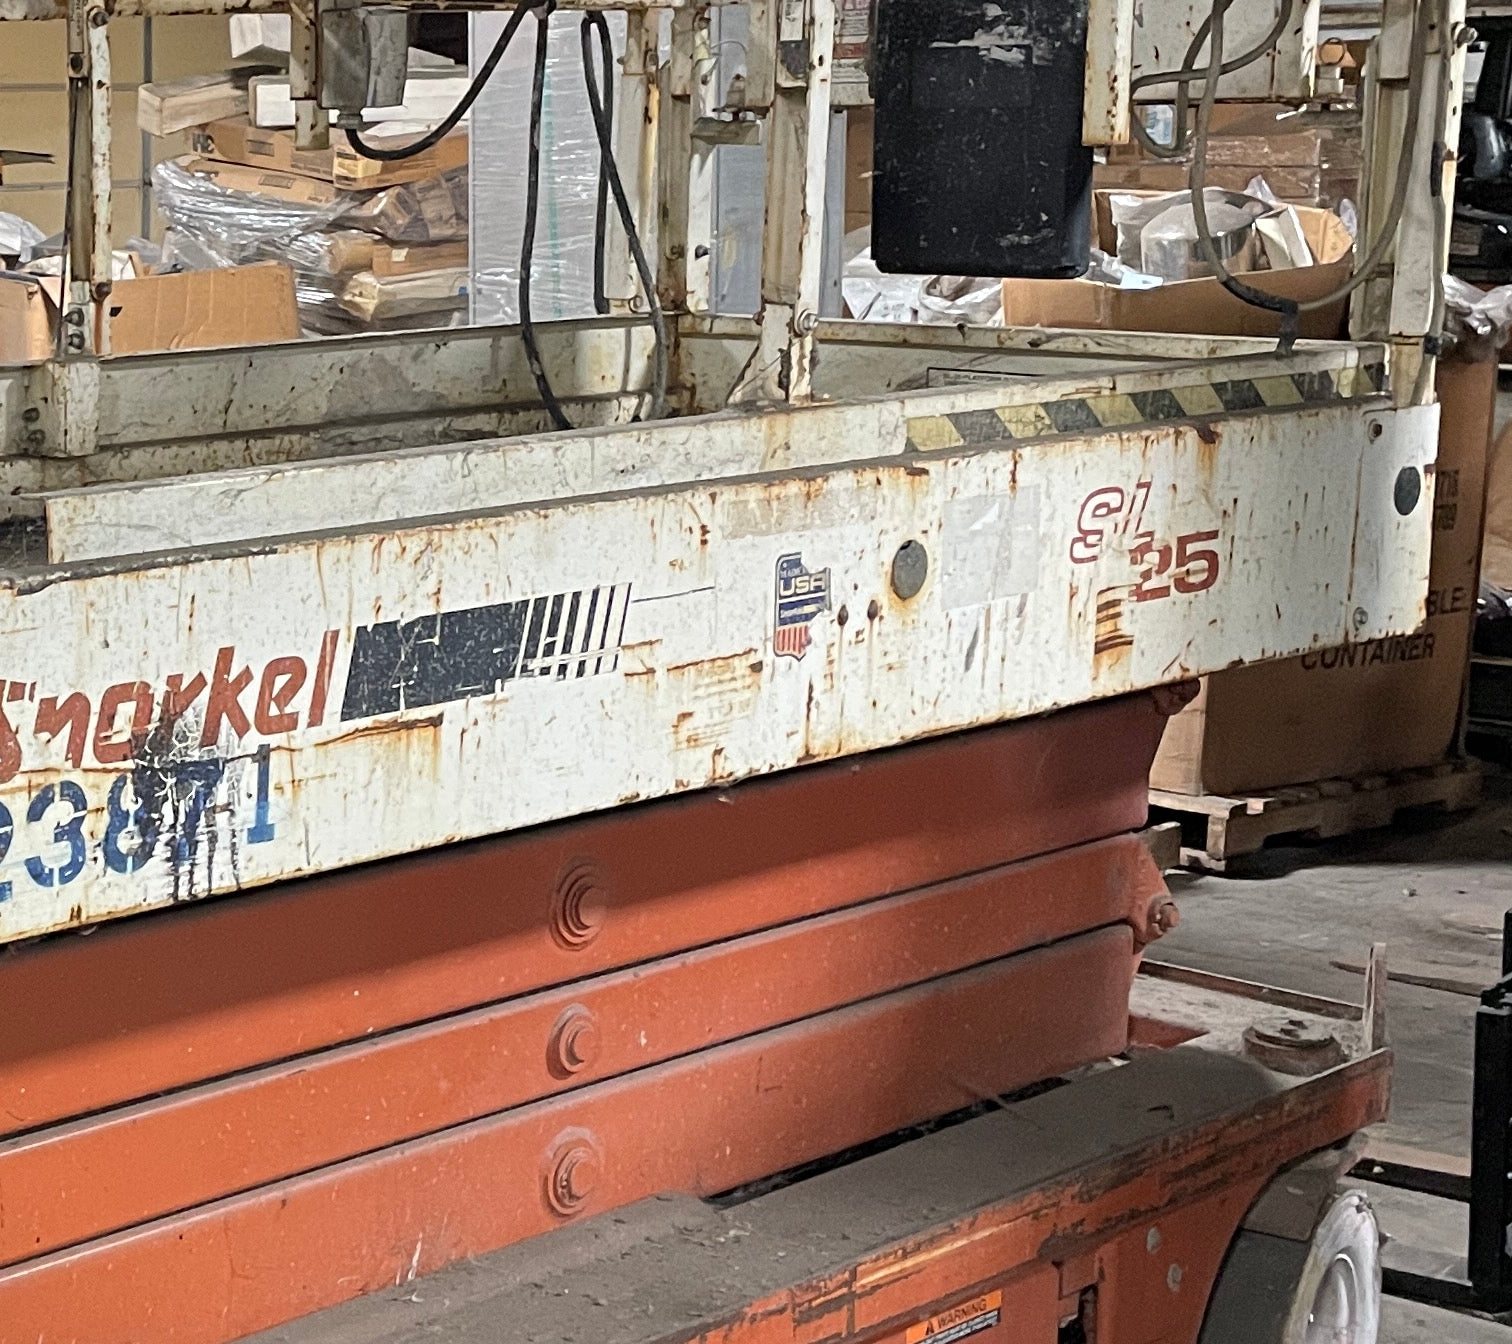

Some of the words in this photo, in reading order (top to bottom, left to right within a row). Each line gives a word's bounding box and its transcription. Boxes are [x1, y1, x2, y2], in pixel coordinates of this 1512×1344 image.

[779, 573, 826, 597] USA
[1128, 530, 1220, 603] 25
[1300, 632, 1437, 671] CONTAINER
